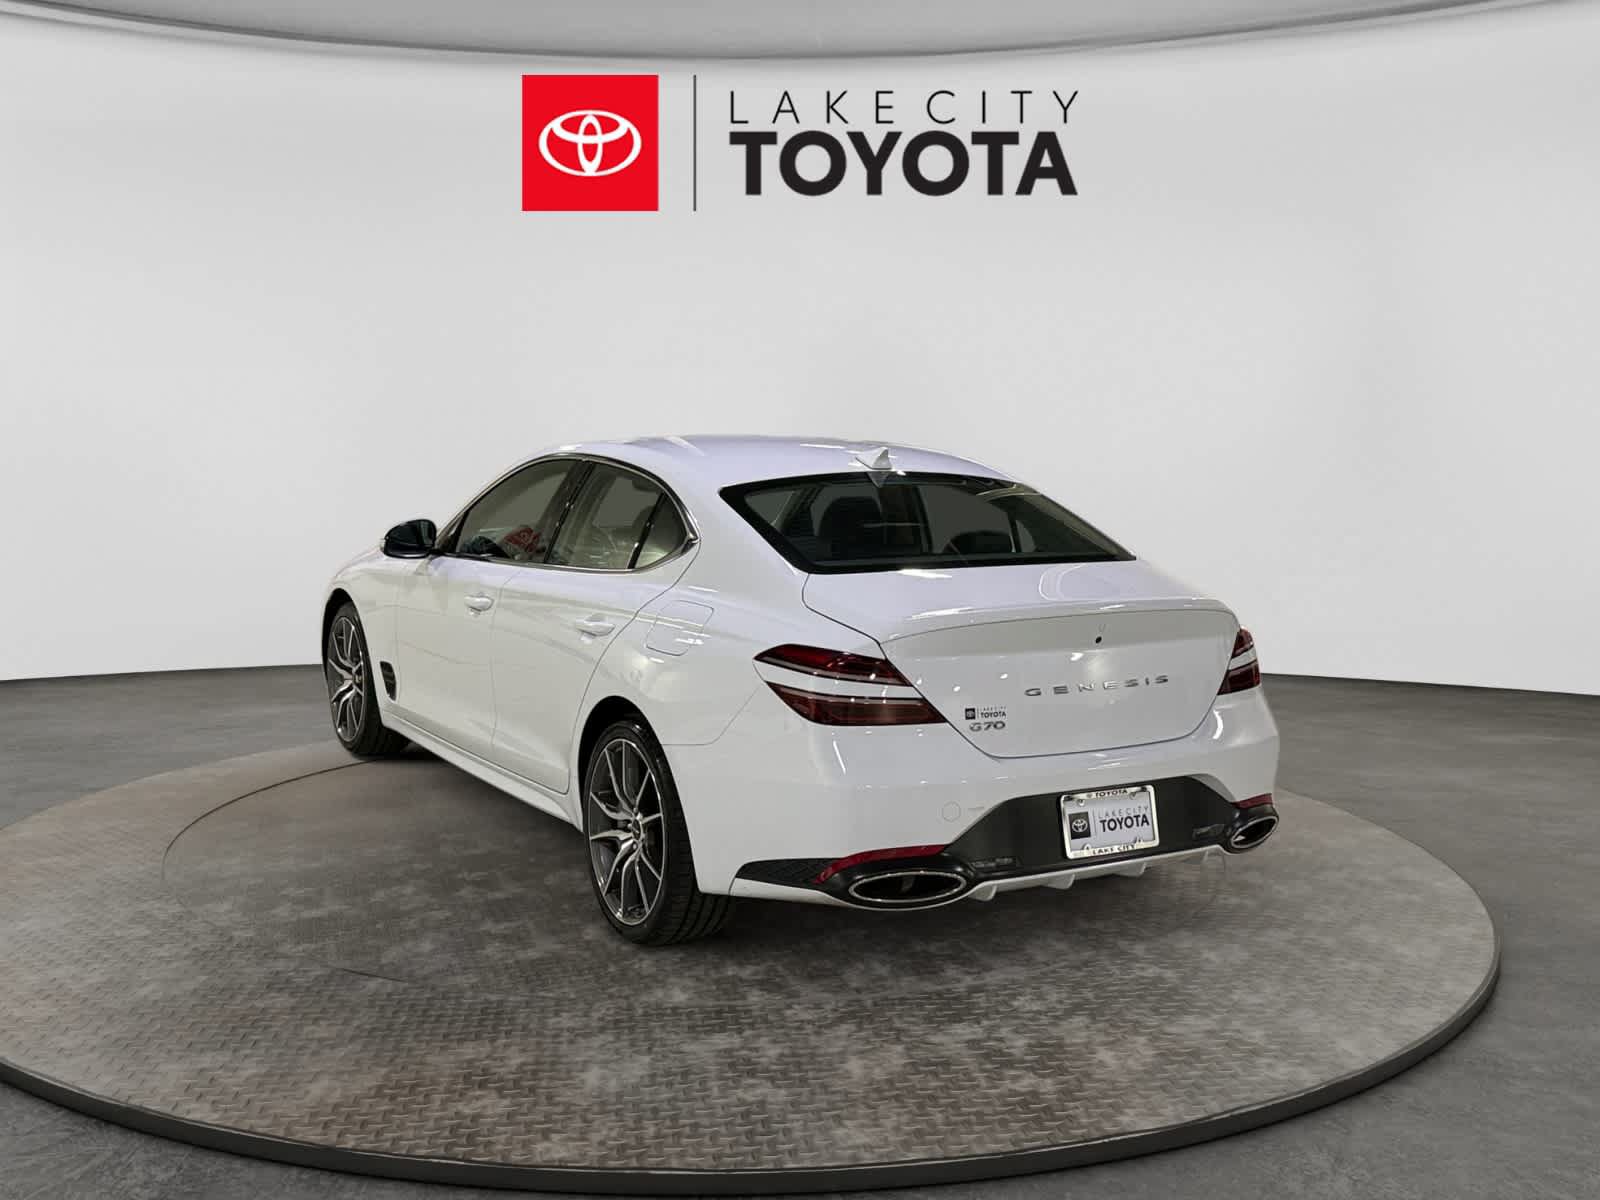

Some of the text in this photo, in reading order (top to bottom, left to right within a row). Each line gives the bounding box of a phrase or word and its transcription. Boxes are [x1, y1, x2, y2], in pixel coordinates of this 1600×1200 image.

[1024, 674, 1169, 697] GENESIS
[980, 711, 1007, 719] TOYOTA
[969, 721, 1005, 732] G70
[1095, 788, 1128, 798] TOYOTA
[1098, 806, 1149, 819] LAKE CITY
[1099, 814, 1150, 833] TOYOTA
[1092, 844, 1135, 855] LAKE CITY
